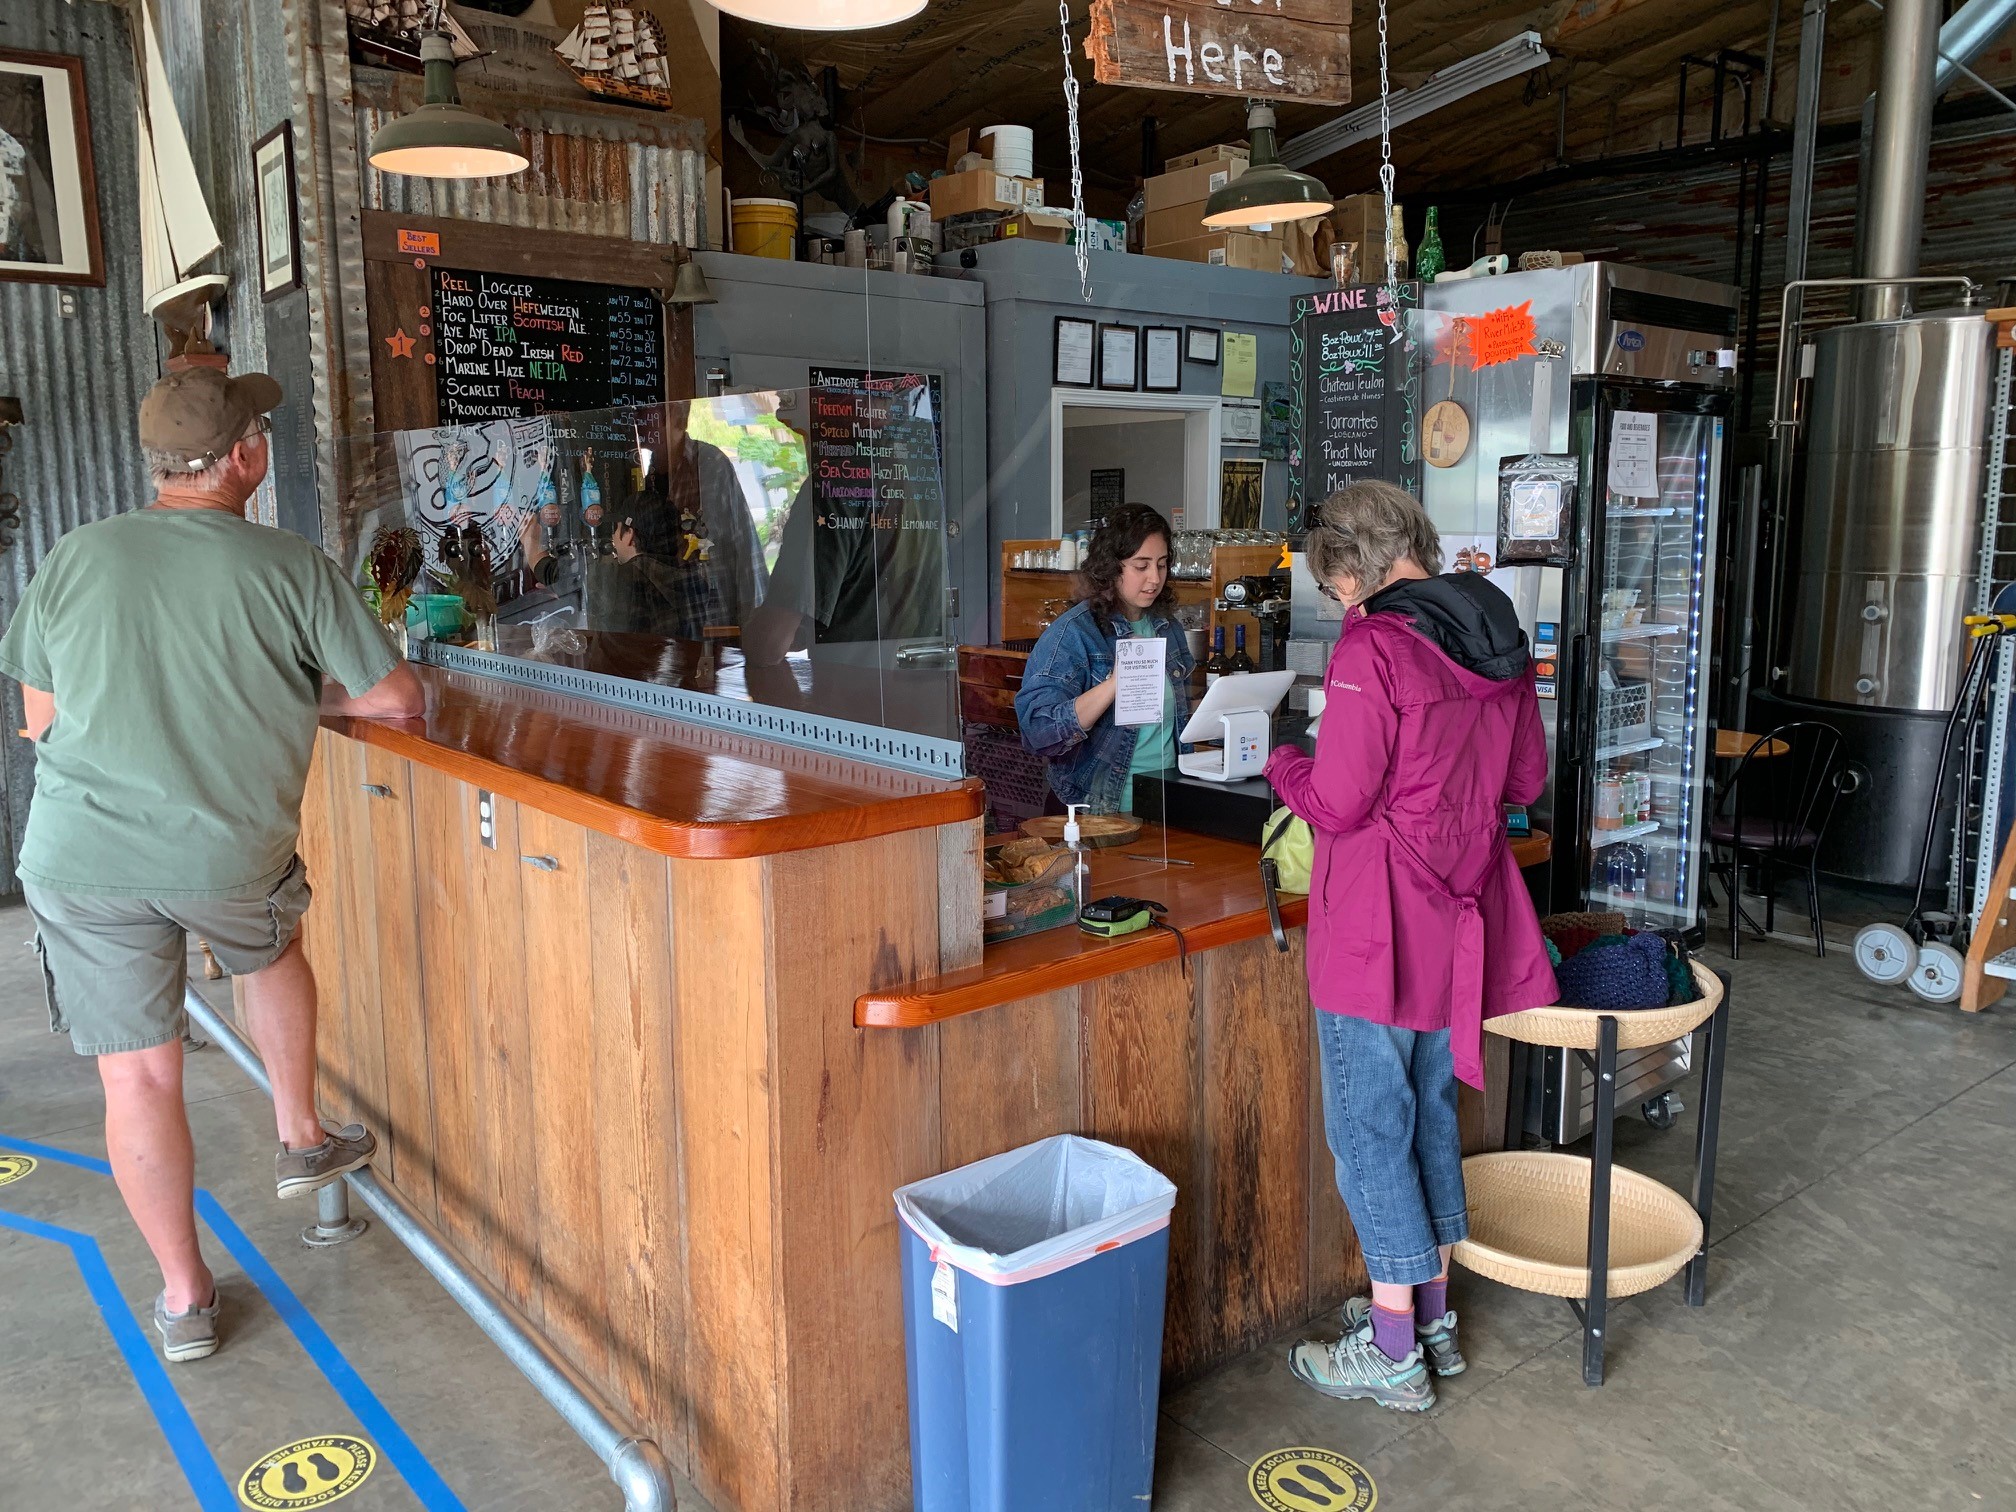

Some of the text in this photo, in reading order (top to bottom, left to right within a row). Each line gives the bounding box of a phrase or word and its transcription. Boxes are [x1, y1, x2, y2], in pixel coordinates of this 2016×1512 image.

[1164, 8, 1289, 90] Here
[406, 231, 427, 243] BEST
[402, 241, 436, 254] SELLERS
[441, 271, 473, 292] REEL
[481, 274, 533, 297] LOGGER
[442, 291, 473, 308] HARD
[478, 292, 507, 310] OVER
[513, 297, 580, 319] HEFEWEIZEN
[1313, 289, 1368, 314] WINE
[442, 306, 466, 323] FOG
[472, 309, 508, 326] LIFTER
[513, 312, 564, 332] SCOTTISH
[569, 318, 586, 335] ALE
[444, 323, 463, 338] AYE
[469, 324, 489, 340] AYE
[494, 325, 517, 344] IPA
[1339, 330, 1364, 344] Pour
[445, 338, 477, 355] DROP
[482, 340, 513, 357] DEAD
[520, 341, 554, 360] IRISH
[561, 344, 584, 363] RED
[645, 356, 657, 369] 34
[1338, 345, 1365, 360] Pour
[445, 356, 490, 375] MARINE
[495, 359, 526, 378] HAZE
[645, 373, 657, 386] 24
[817, 370, 860, 389] ANTIDOTE
[446, 378, 500, 397] SCARLET
[508, 379, 545, 400] PEACH
[448, 399, 522, 418] PROVOCATIVE
[818, 396, 853, 417] FREEDOM
[855, 398, 888, 420] FIGHTER
[1323, 411, 1379, 430] Torrontes
[544, 423, 577, 440] CIDER
[820, 422, 850, 438] SPICED
[852, 422, 883, 440] MUTINY
[856, 441, 894, 458] MISCHIEF
[1321, 440, 1377, 460] Pinot Noir
[820, 460, 910, 481] SEA SIREN HAZY IPA
[880, 485, 905, 500] CIDER
[827, 513, 865, 530] SHANDY
[901, 514, 939, 530] LEMONADE
[1333, 680, 1362, 692] Columbia
[1536, 686, 1553, 694] VISA
[293, 1439, 335, 1452] STAND
[248, 1443, 367, 1507] PLEASE KEEP SOCIAL DISTANCE
[1256, 1469, 1267, 1491] KEEP
[1262, 1451, 1300, 1471] SOCIAL
[1302, 1451, 1360, 1477] DISTANCE
[1356, 1486, 1369, 1508] HERE
